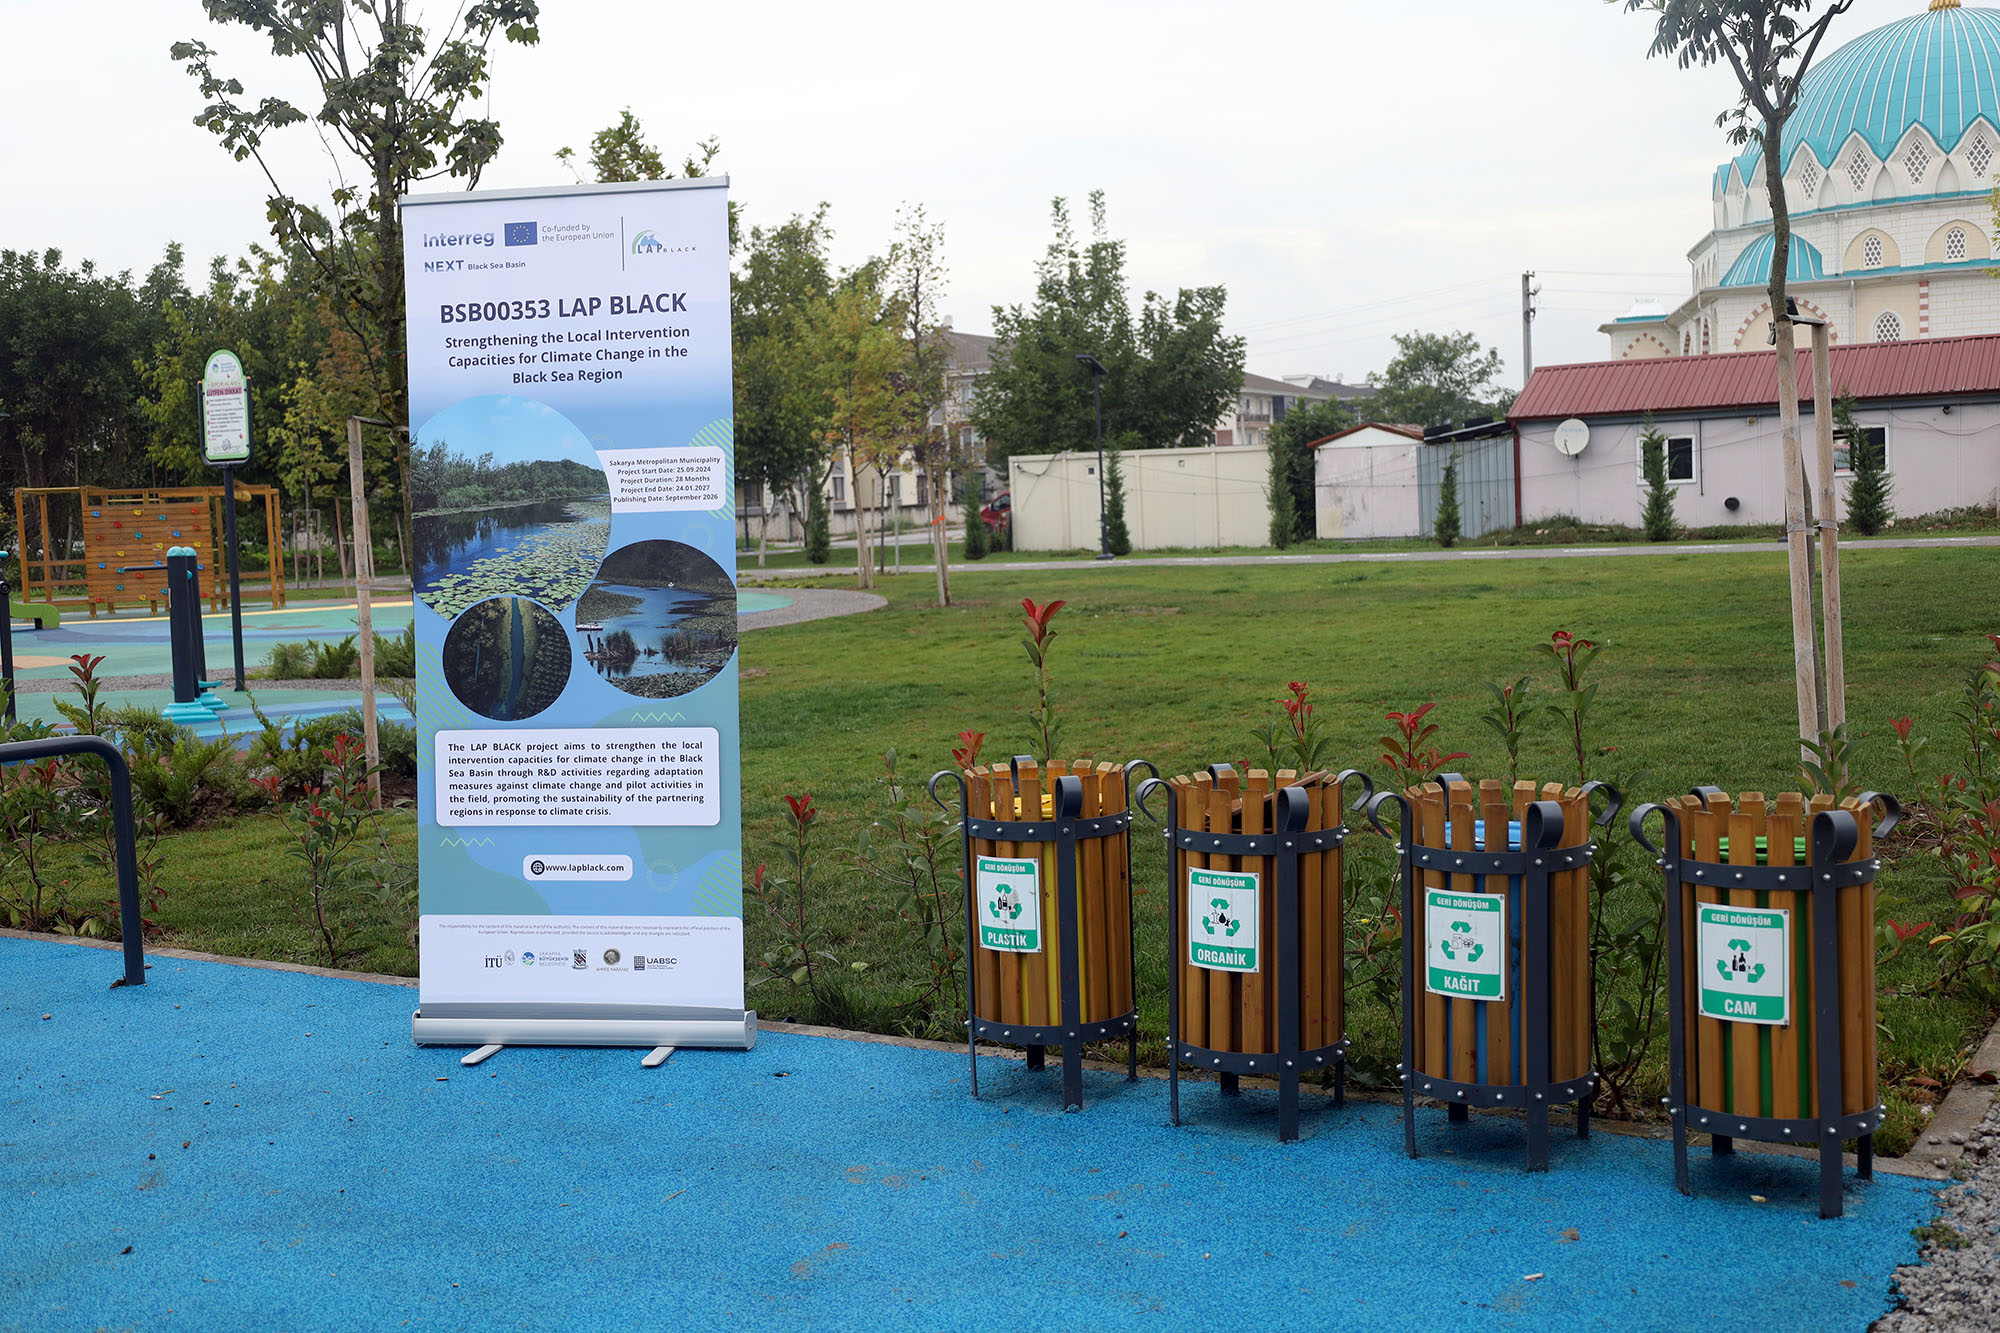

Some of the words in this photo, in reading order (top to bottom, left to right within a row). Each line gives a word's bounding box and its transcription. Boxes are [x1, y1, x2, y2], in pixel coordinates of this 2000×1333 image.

[541, 224, 580, 233] Co-funded
[581, 223, 591, 233] by
[423, 232, 494, 248] Interreg
[541, 234, 555, 242] the
[555, 233, 591, 242] European
[592, 231, 615, 240] Union
[637, 243, 663, 254] LAP
[424, 259, 464, 273] NEXT
[467, 262, 489, 271] Black
[489, 262, 504, 270] Sea
[505, 260, 526, 269] Basin
[440, 299, 551, 324] BSB00353
[558, 296, 602, 318] LAP
[610, 292, 687, 315] BLACK
[445, 333, 538, 350] Strengthening
[541, 331, 564, 344] the
[567, 329, 601, 343] Local
[605, 326, 690, 341] Intervention
[448, 353, 515, 370] Capacities
[518, 352, 537, 364] for
[541, 351, 592, 363] Climate
[595, 348, 645, 363] Change
[648, 346, 660, 358] in
[664, 345, 688, 358] the
[513, 371, 547, 384] Black
[551, 370, 573, 382] Sea
[578, 369, 622, 384] Region
[609, 459, 635, 467] Sakarya
[636, 458, 678, 466] Metropolitan
[679, 456, 720, 465] Municipality
[620, 478, 643, 486] Project
[620, 487, 644, 495] Project
[665, 494, 701, 502] September
[448, 743, 465, 752] The
[470, 743, 487, 751] LAP
[493, 742, 521, 751] BLACK
[526, 742, 558, 753] project
[564, 742, 585, 750] aims
[606, 741, 656, 752] strengthen
[662, 741, 677, 750] the
[682, 741, 702, 749] local
[448, 755, 505, 765] intervention
[508, 755, 553, 766] capacities
[556, 755, 570, 764] for
[573, 755, 607, 763] climate
[611, 754, 644, 765] change
[647, 754, 656, 763] in
[660, 754, 676, 763] the
[679, 754, 703, 763] Black
[449, 769, 464, 778] Sea
[469, 769, 493, 777] Basin
[497, 768, 533, 779] through
[538, 768, 556, 777] R&D
[561, 768, 602, 777] activities
[606, 768, 650, 779] regarding
[654, 767, 703, 778] adaptation
[496, 781, 529, 792] against
[532, 781, 566, 790] climate
[569, 781, 602, 792] change
[605, 781, 622, 789] and
[626, 781, 647, 791] pilot
[650, 780, 692, 789] activities
[695, 780, 704, 789] in
[449, 795, 465, 803] the
[467, 795, 490, 804] field,
[493, 795, 540, 805] promoting
[543, 794, 558, 803] the
[561, 794, 623, 804] sustainability
[625, 794, 635, 802] of
[637, 794, 653, 802] the
[656, 794, 704, 804] partnering
[449, 808, 483, 818] regions
[485, 807, 494, 816] in
[495, 808, 536, 818] response
[538, 808, 548, 816] to
[549, 807, 584, 816] climate
[585, 807, 611, 816] crisis.
[545, 863, 624, 873] www.lapblack.com
[997, 864, 1026, 873] DÖNÜŞÜM
[1198, 875, 1212, 884] GERİ
[1213, 877, 1246, 887] DÖNÜŞÜM
[1436, 897, 1452, 906] GERİ
[1453, 899, 1489, 910] DÖNÜŞÜM
[1711, 913, 1728, 923] GERİ
[1730, 914, 1772, 927] DÖNÜŞÜM
[987, 931, 1028, 946] PLASTİK
[1197, 948, 1247, 966] ORGANİK
[1443, 975, 1481, 992] KAĞIT
[1724, 998, 1757, 1015] CAM
